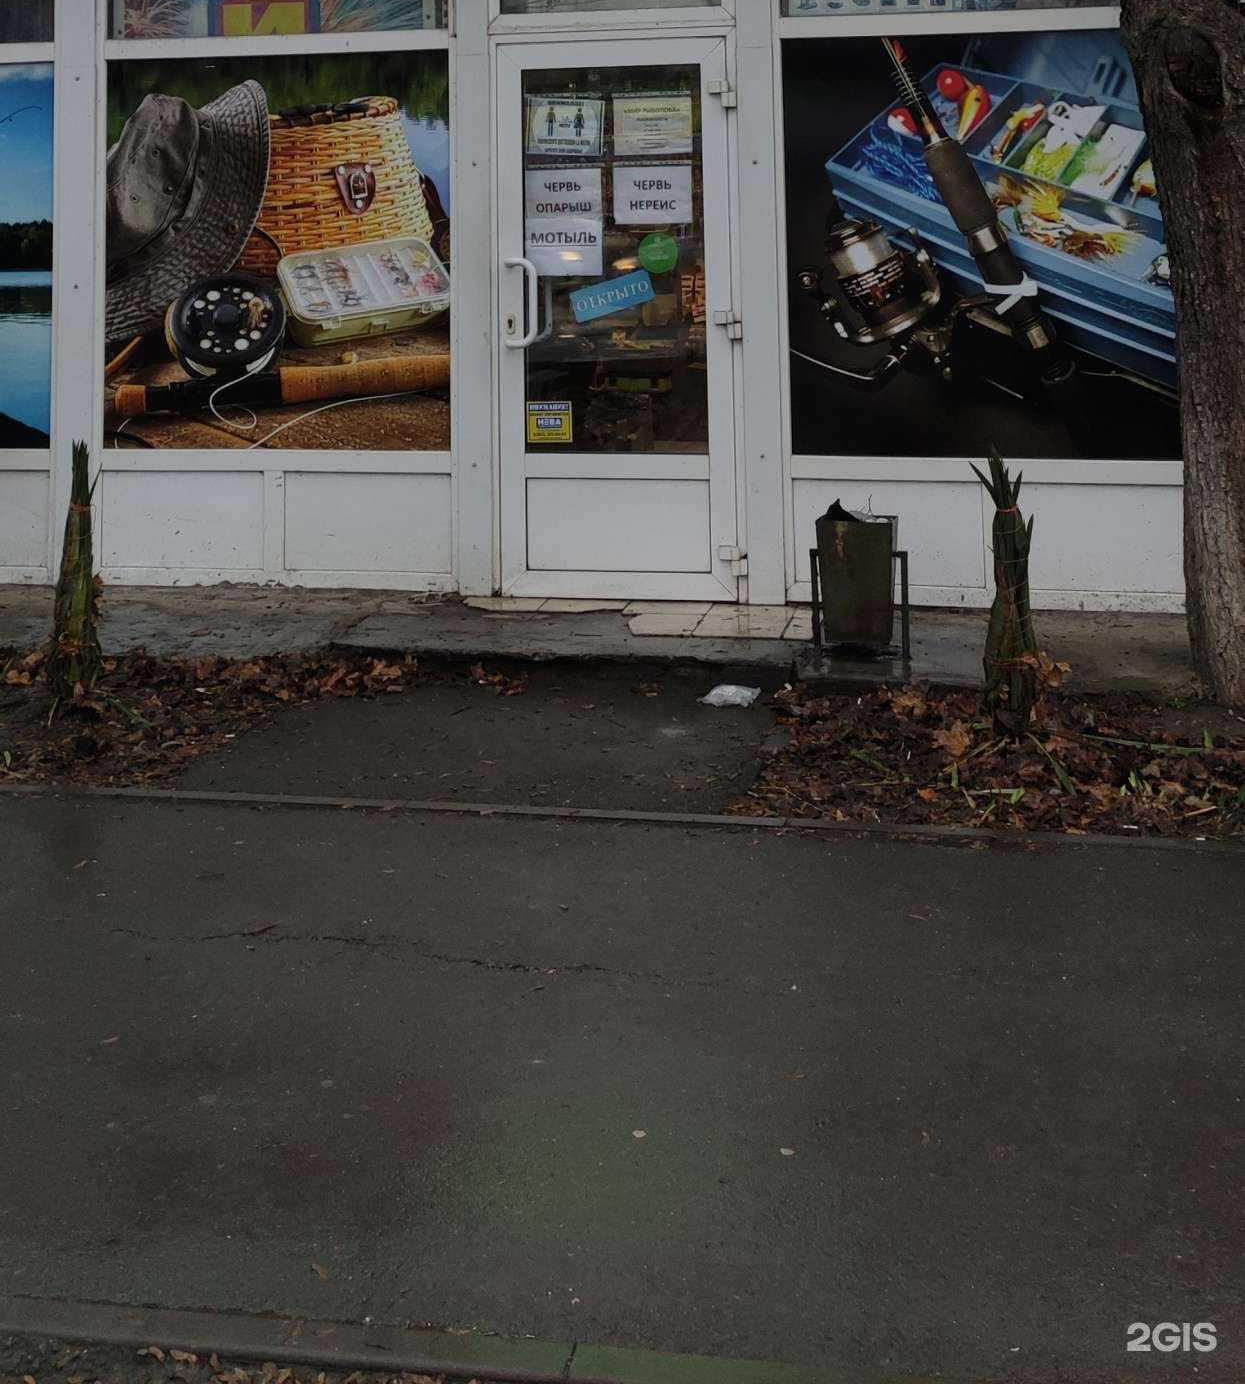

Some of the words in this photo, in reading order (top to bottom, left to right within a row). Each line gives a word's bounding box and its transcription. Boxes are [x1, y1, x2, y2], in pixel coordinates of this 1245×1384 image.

[544, 181, 581, 192] ЧЕРВЬ
[633, 179, 672, 191] ЧЕРВЬ
[536, 201, 592, 213] ОПАРЫШ
[629, 199, 677, 211] НЕРЕИС
[530, 231, 597, 244] МОТЫЛЬ
[576, 280, 649, 312] ОТКРЫТО
